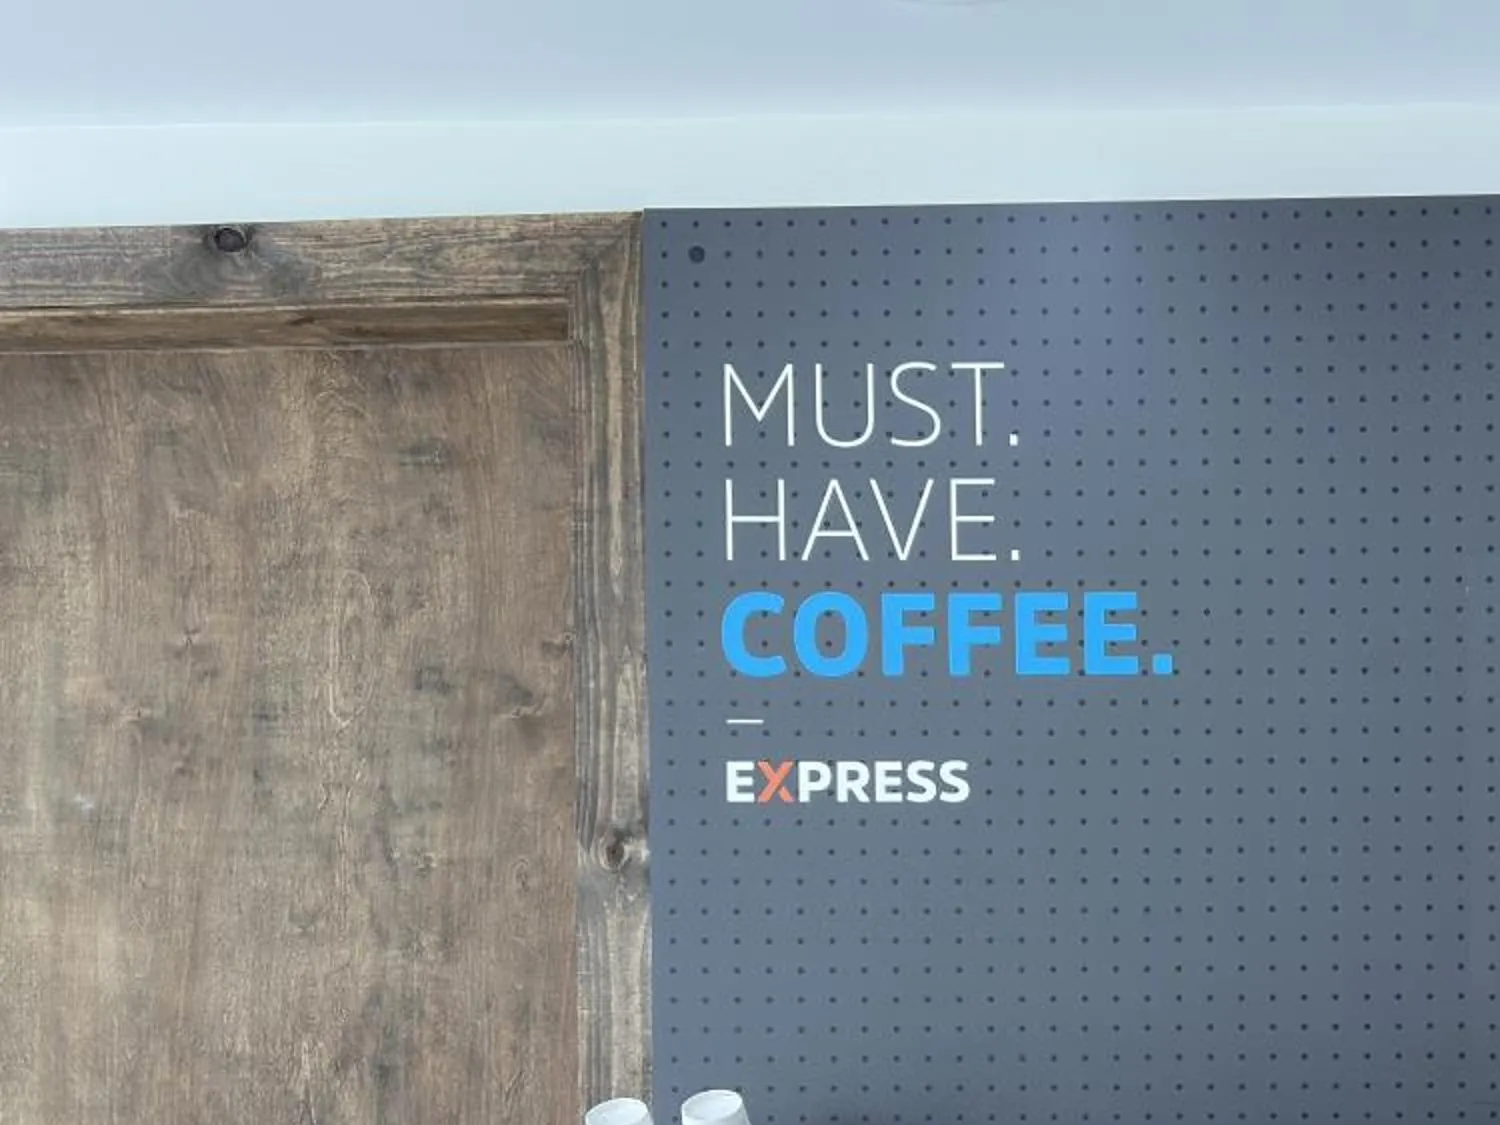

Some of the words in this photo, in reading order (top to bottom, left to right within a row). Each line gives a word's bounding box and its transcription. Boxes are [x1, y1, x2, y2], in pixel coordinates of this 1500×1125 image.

[723, 361, 1019, 447] MUST.
[725, 478, 1021, 561] HAVE.
[721, 592, 1173, 677] COFFEE.
[726, 761, 970, 803] EXPRESS
